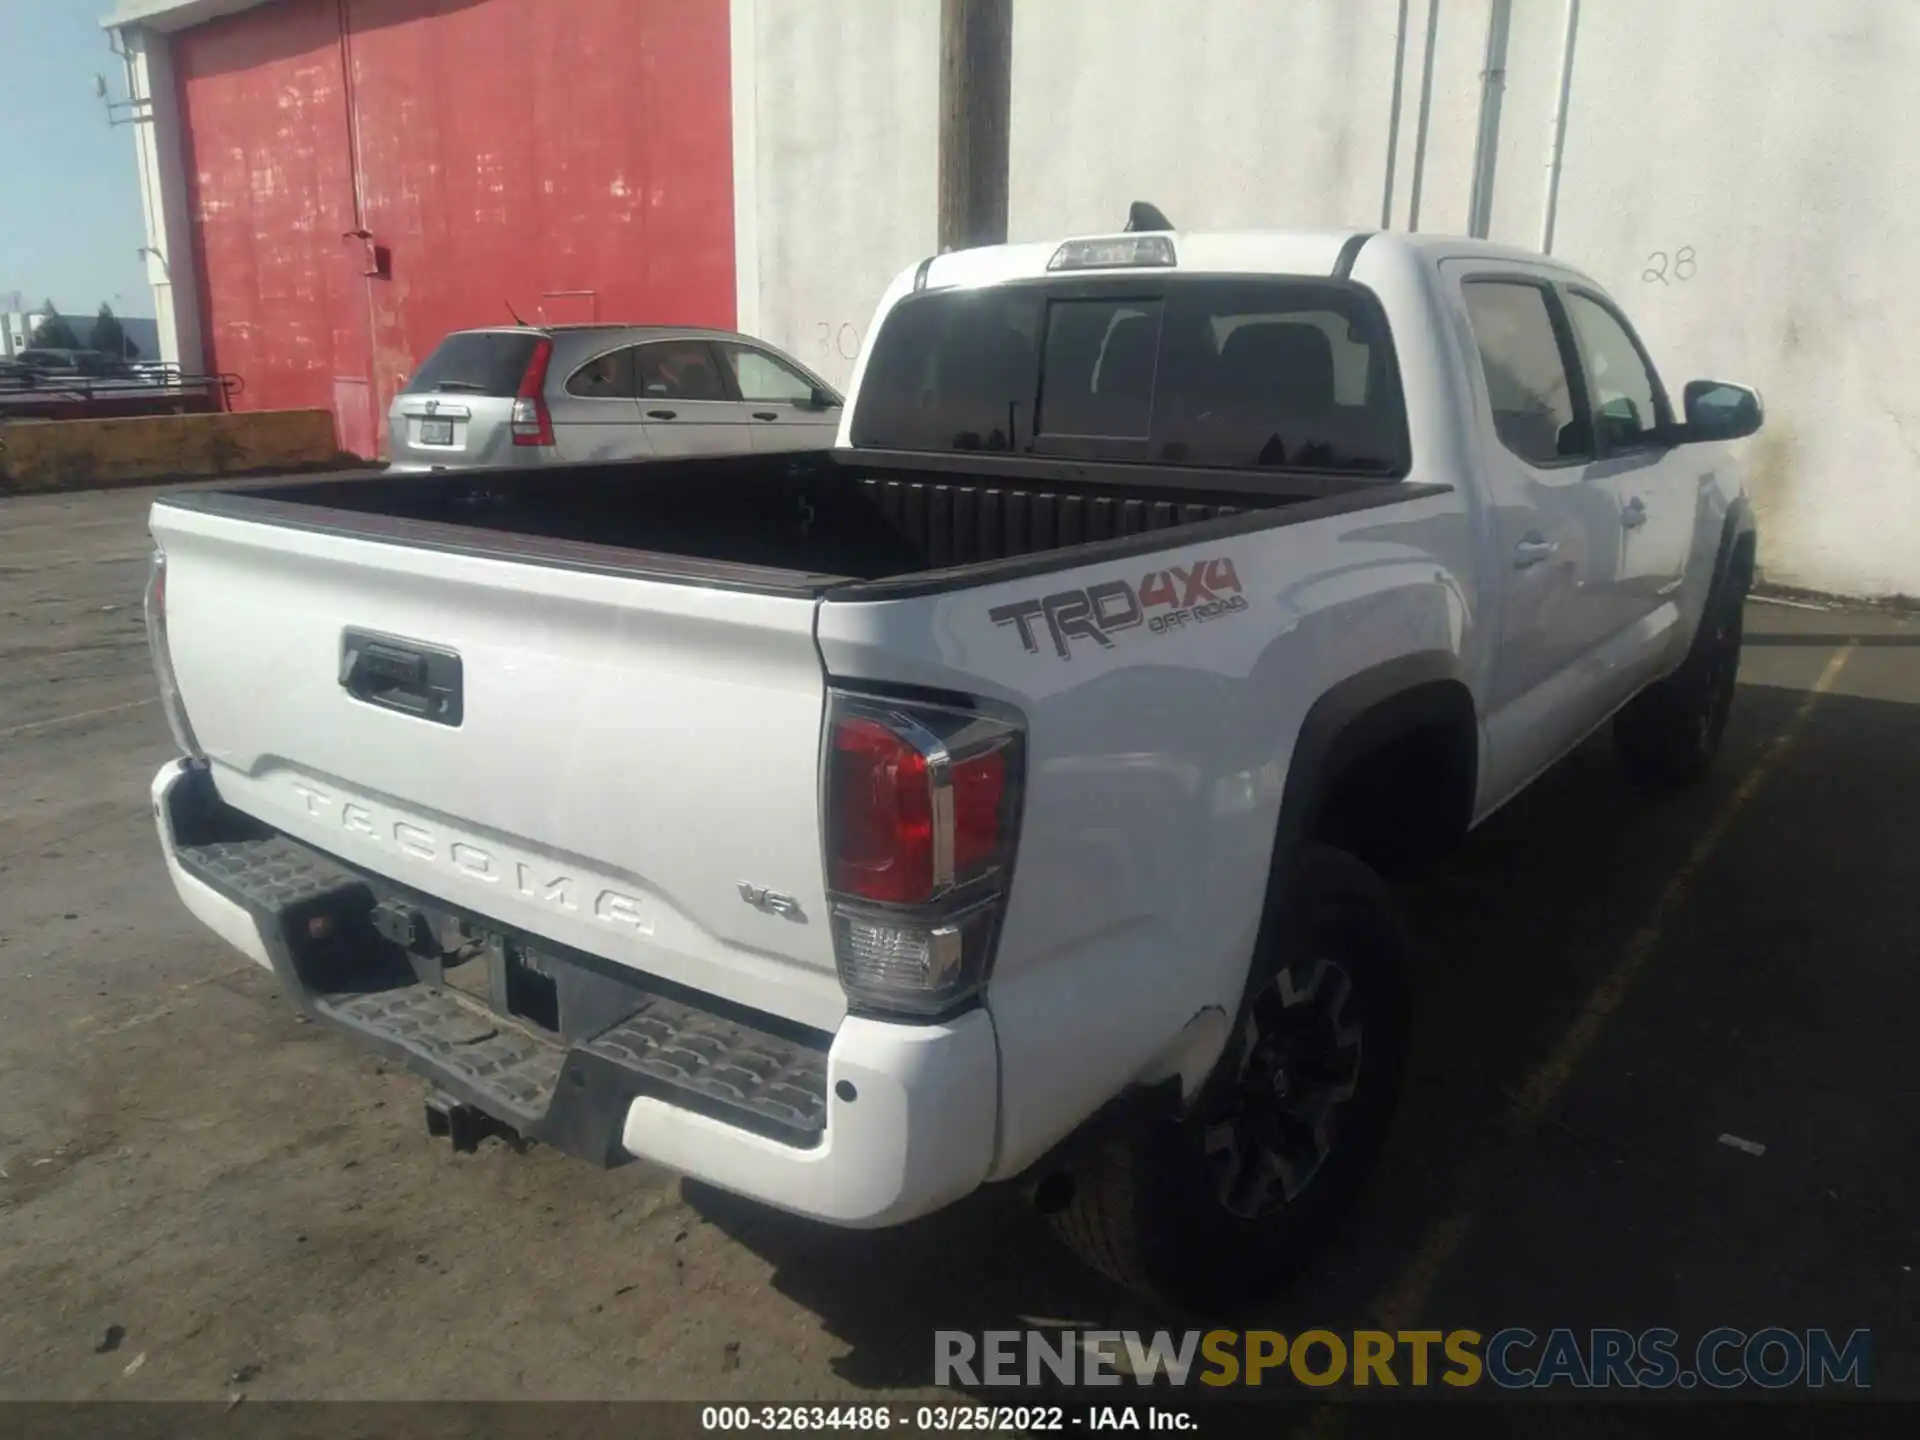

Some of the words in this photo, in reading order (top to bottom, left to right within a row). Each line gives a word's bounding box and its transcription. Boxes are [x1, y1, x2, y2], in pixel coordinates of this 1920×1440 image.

[1641, 244, 1697, 287] 28
[816, 321, 861, 360] 30
[988, 579, 1144, 661] TRD
[1148, 610, 1192, 635] OFF
[1193, 594, 1250, 624] ROAD
[291, 780, 656, 937] TACOMA
